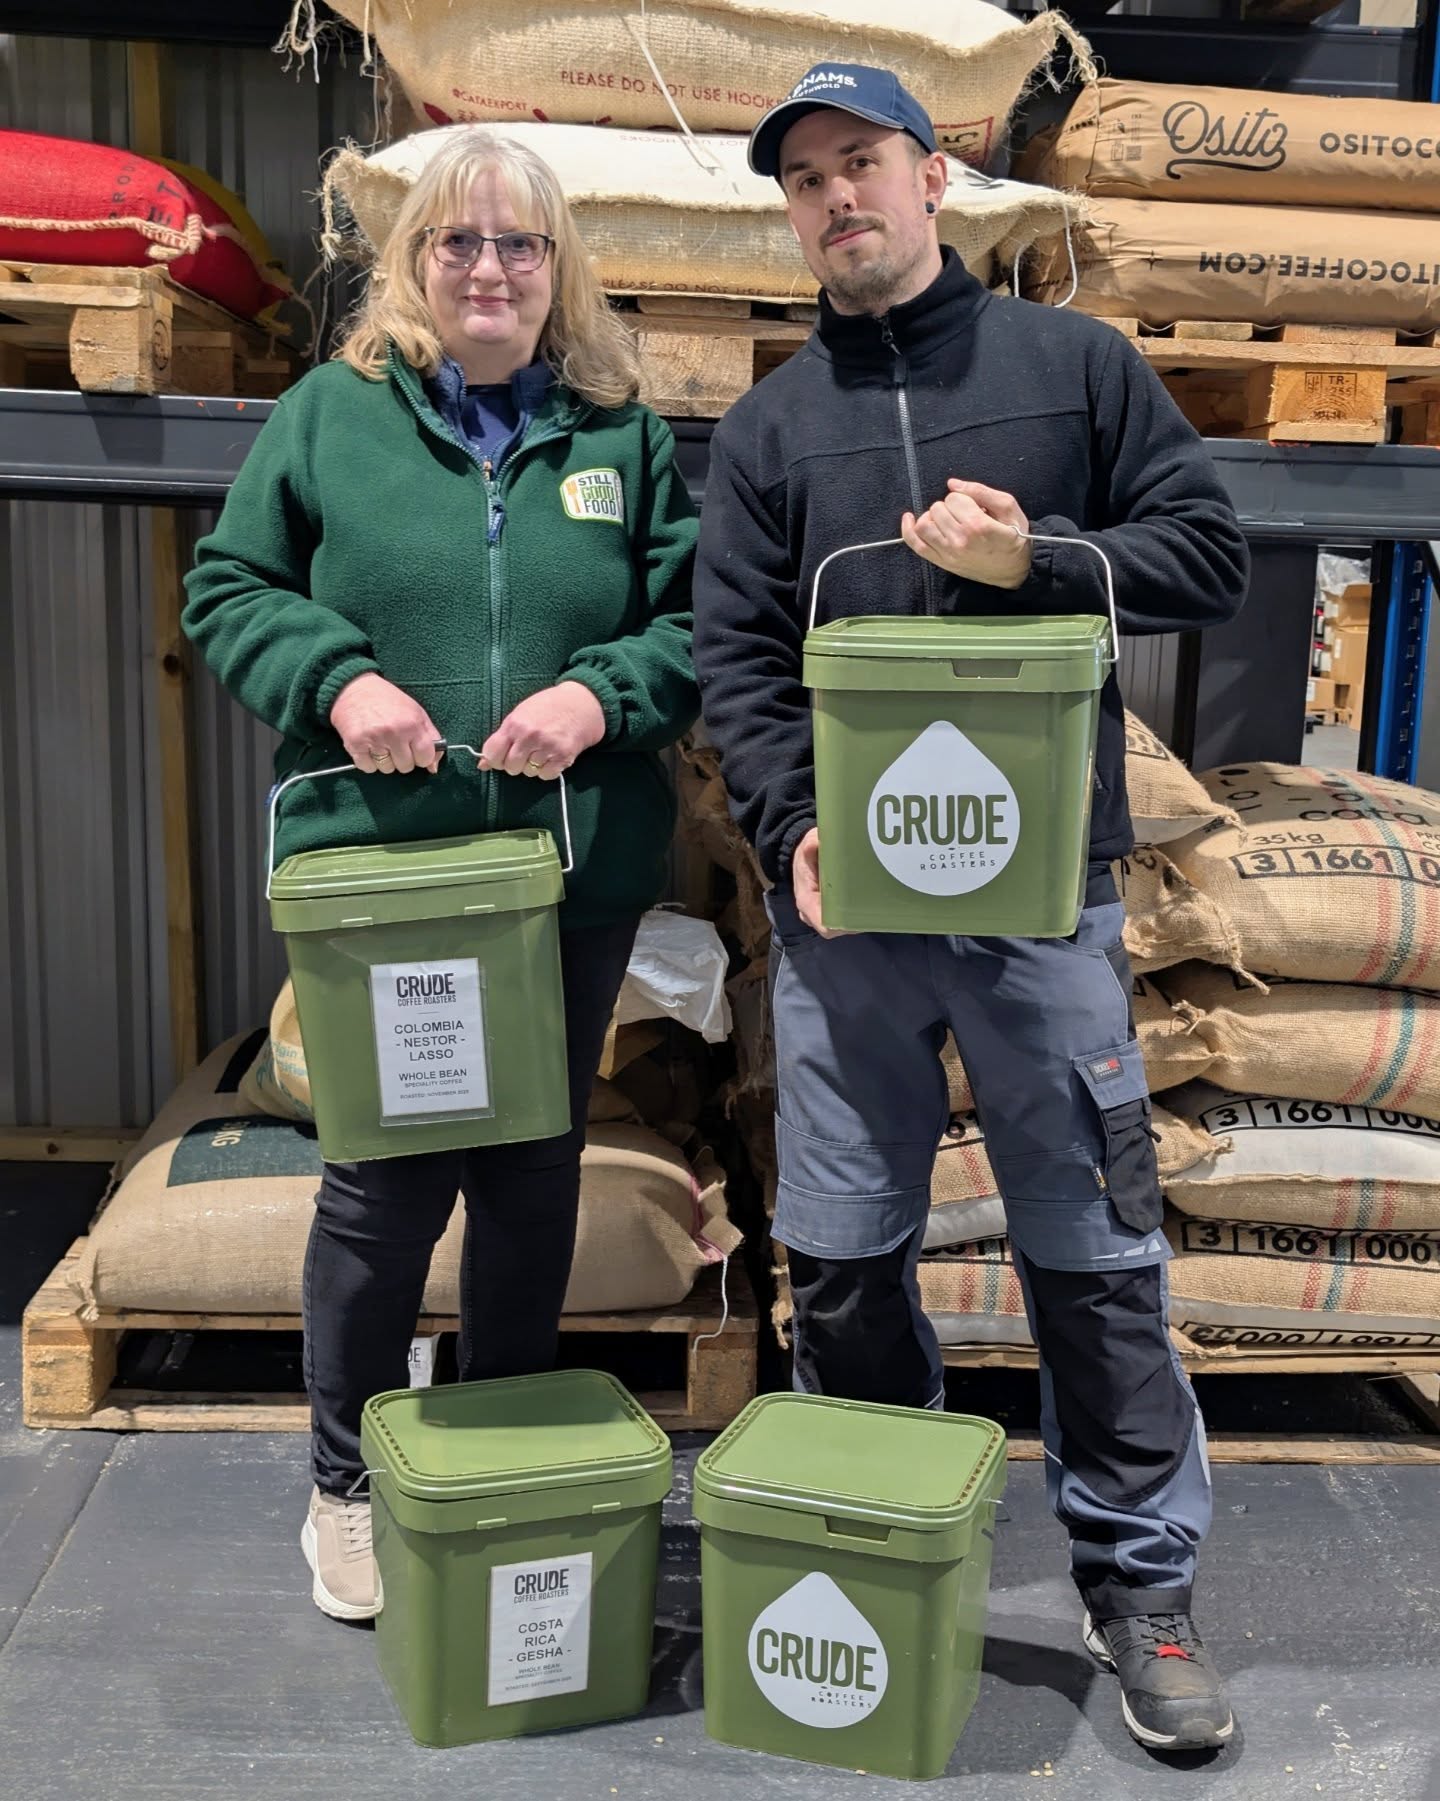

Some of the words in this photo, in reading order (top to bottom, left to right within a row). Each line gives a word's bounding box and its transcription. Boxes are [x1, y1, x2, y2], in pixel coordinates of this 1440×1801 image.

[560, 70, 615, 89] PLEASE
[621, 76, 645, 93] DO
[691, 85, 721, 102] USE
[1162, 100, 1289, 180] Osito
[601, 278, 658, 290] PLEASE
[578, 474, 613, 486] STILL
[581, 485, 616, 501] GOOD
[584, 499, 617, 516] FOOD
[876, 794, 1009, 846] CRUDE
[1298, 807, 1433, 827] cata
[929, 850, 985, 862] COFFEE
[1250, 853, 1277, 872] 3
[1301, 848, 1394, 873] 1661
[919, 859, 997, 871] ROASTERS
[395, 972, 457, 999] CRUDE
[397, 996, 423, 1007] COFFEE
[423, 994, 458, 1006] ROASTERS
[394, 1020, 465, 1035] COLOMBIA
[404, 1034, 458, 1048] NESTOR
[409, 1048, 454, 1062] LASSO
[398, 1071, 437, 1082] WHOLE
[439, 1067, 467, 1079] BEAN
[1215, 1107, 1240, 1127] 3
[1263, 1101, 1353, 1124] 1661
[1199, 1225, 1222, 1247] 3
[1249, 1225, 1338, 1257] 1661
[514, 1568, 570, 1596] CRUDE
[513, 1593, 537, 1604] COFFEE
[537, 1588, 569, 1601] ROASTERS
[518, 1618, 564, 1634] COSTA
[524, 1633, 557, 1648] RICA
[516, 1647, 563, 1663] GESHA
[756, 1628, 877, 1692] CRUDE
[519, 1666, 541, 1674] WHOLE
[543, 1663, 561, 1671] BEAN
[811, 1696, 872, 1709] ROASTERS
[818, 1690, 864, 1701] COFFEE
